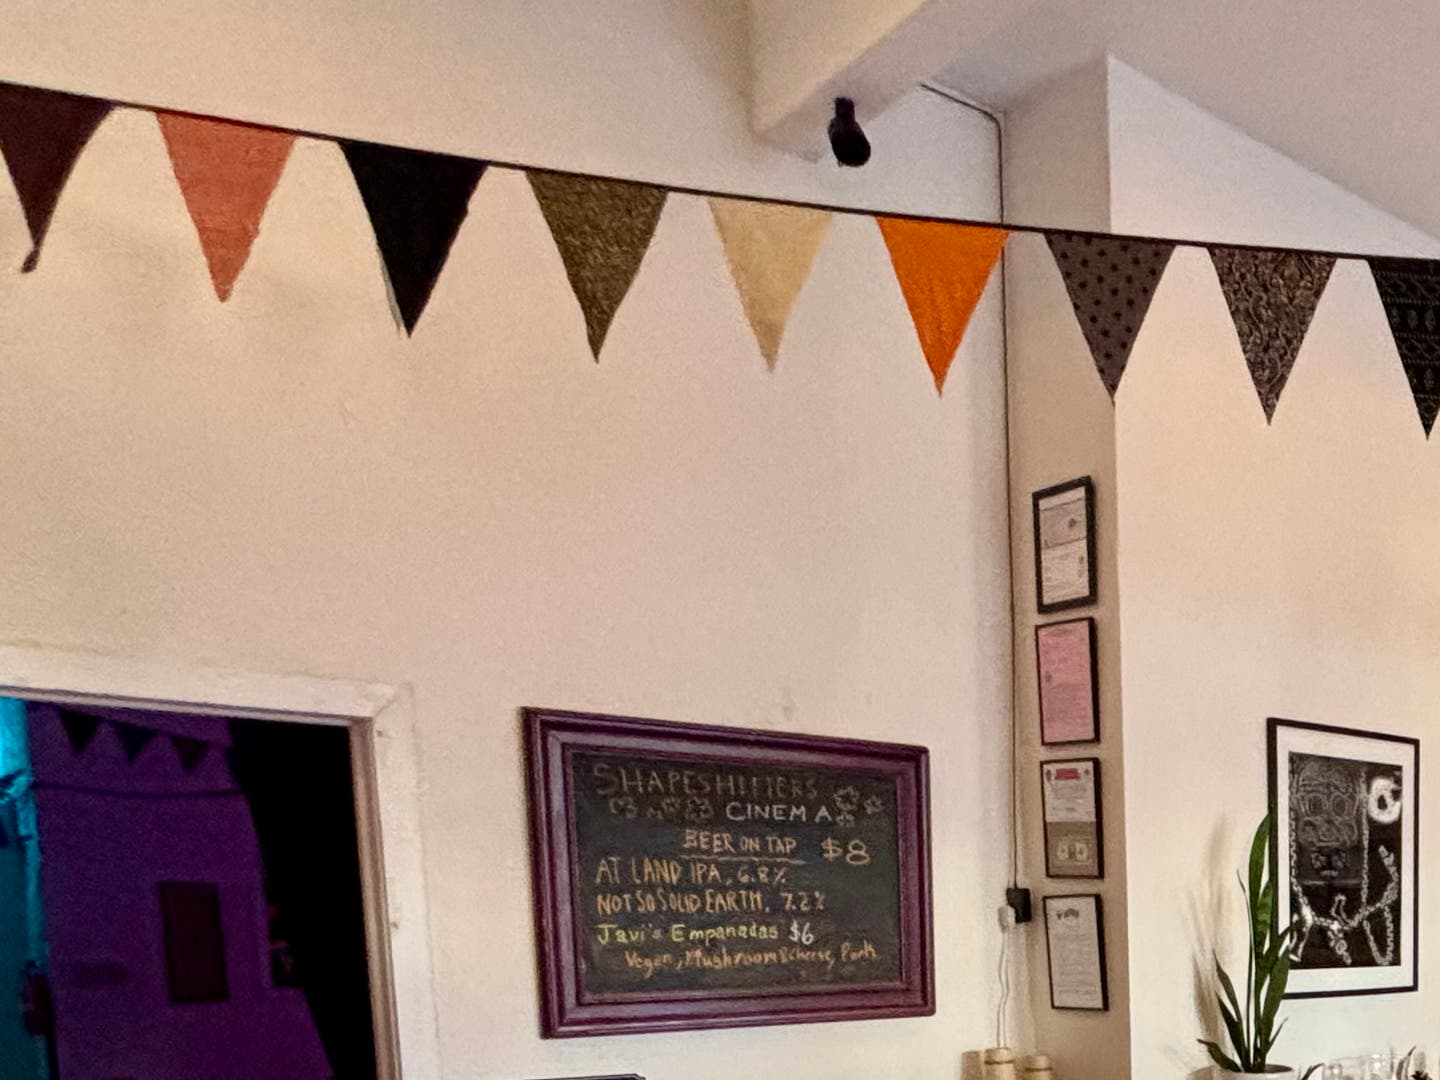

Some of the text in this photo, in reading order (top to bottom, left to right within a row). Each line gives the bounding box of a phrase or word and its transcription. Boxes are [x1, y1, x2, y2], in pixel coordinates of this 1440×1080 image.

[725, 801, 833, 824] CINEMA
[682, 828, 797, 854] BEER ON TAP
[821, 836, 871, 866] $8
[596, 892, 631, 915] NOT
[670, 921, 779, 946] Empanadas
[788, 919, 815, 946] $6
